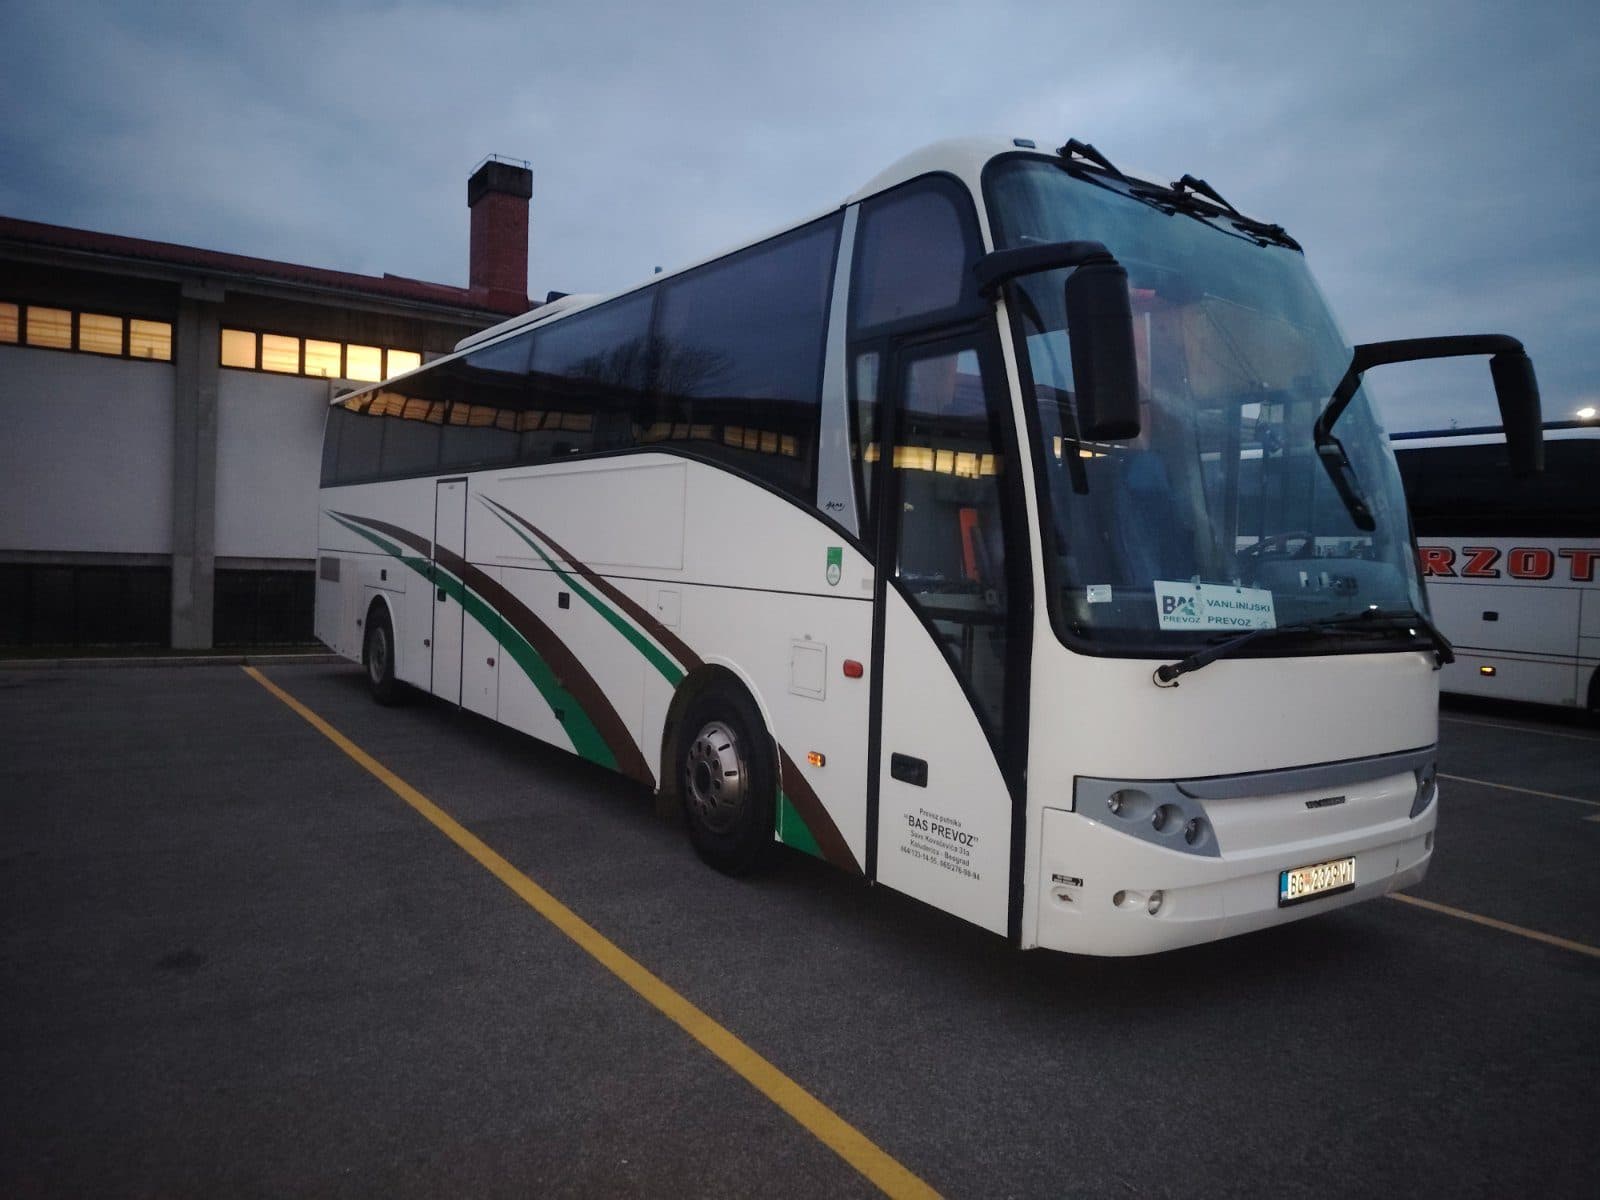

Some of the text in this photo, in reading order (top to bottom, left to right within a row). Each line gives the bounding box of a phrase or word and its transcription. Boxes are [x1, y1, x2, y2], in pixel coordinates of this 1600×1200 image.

[1206, 599, 1271, 613] VANLINIJSKI
[1163, 615, 1201, 624] PREVOZ
[1207, 615, 1252, 627] PREVOZ
